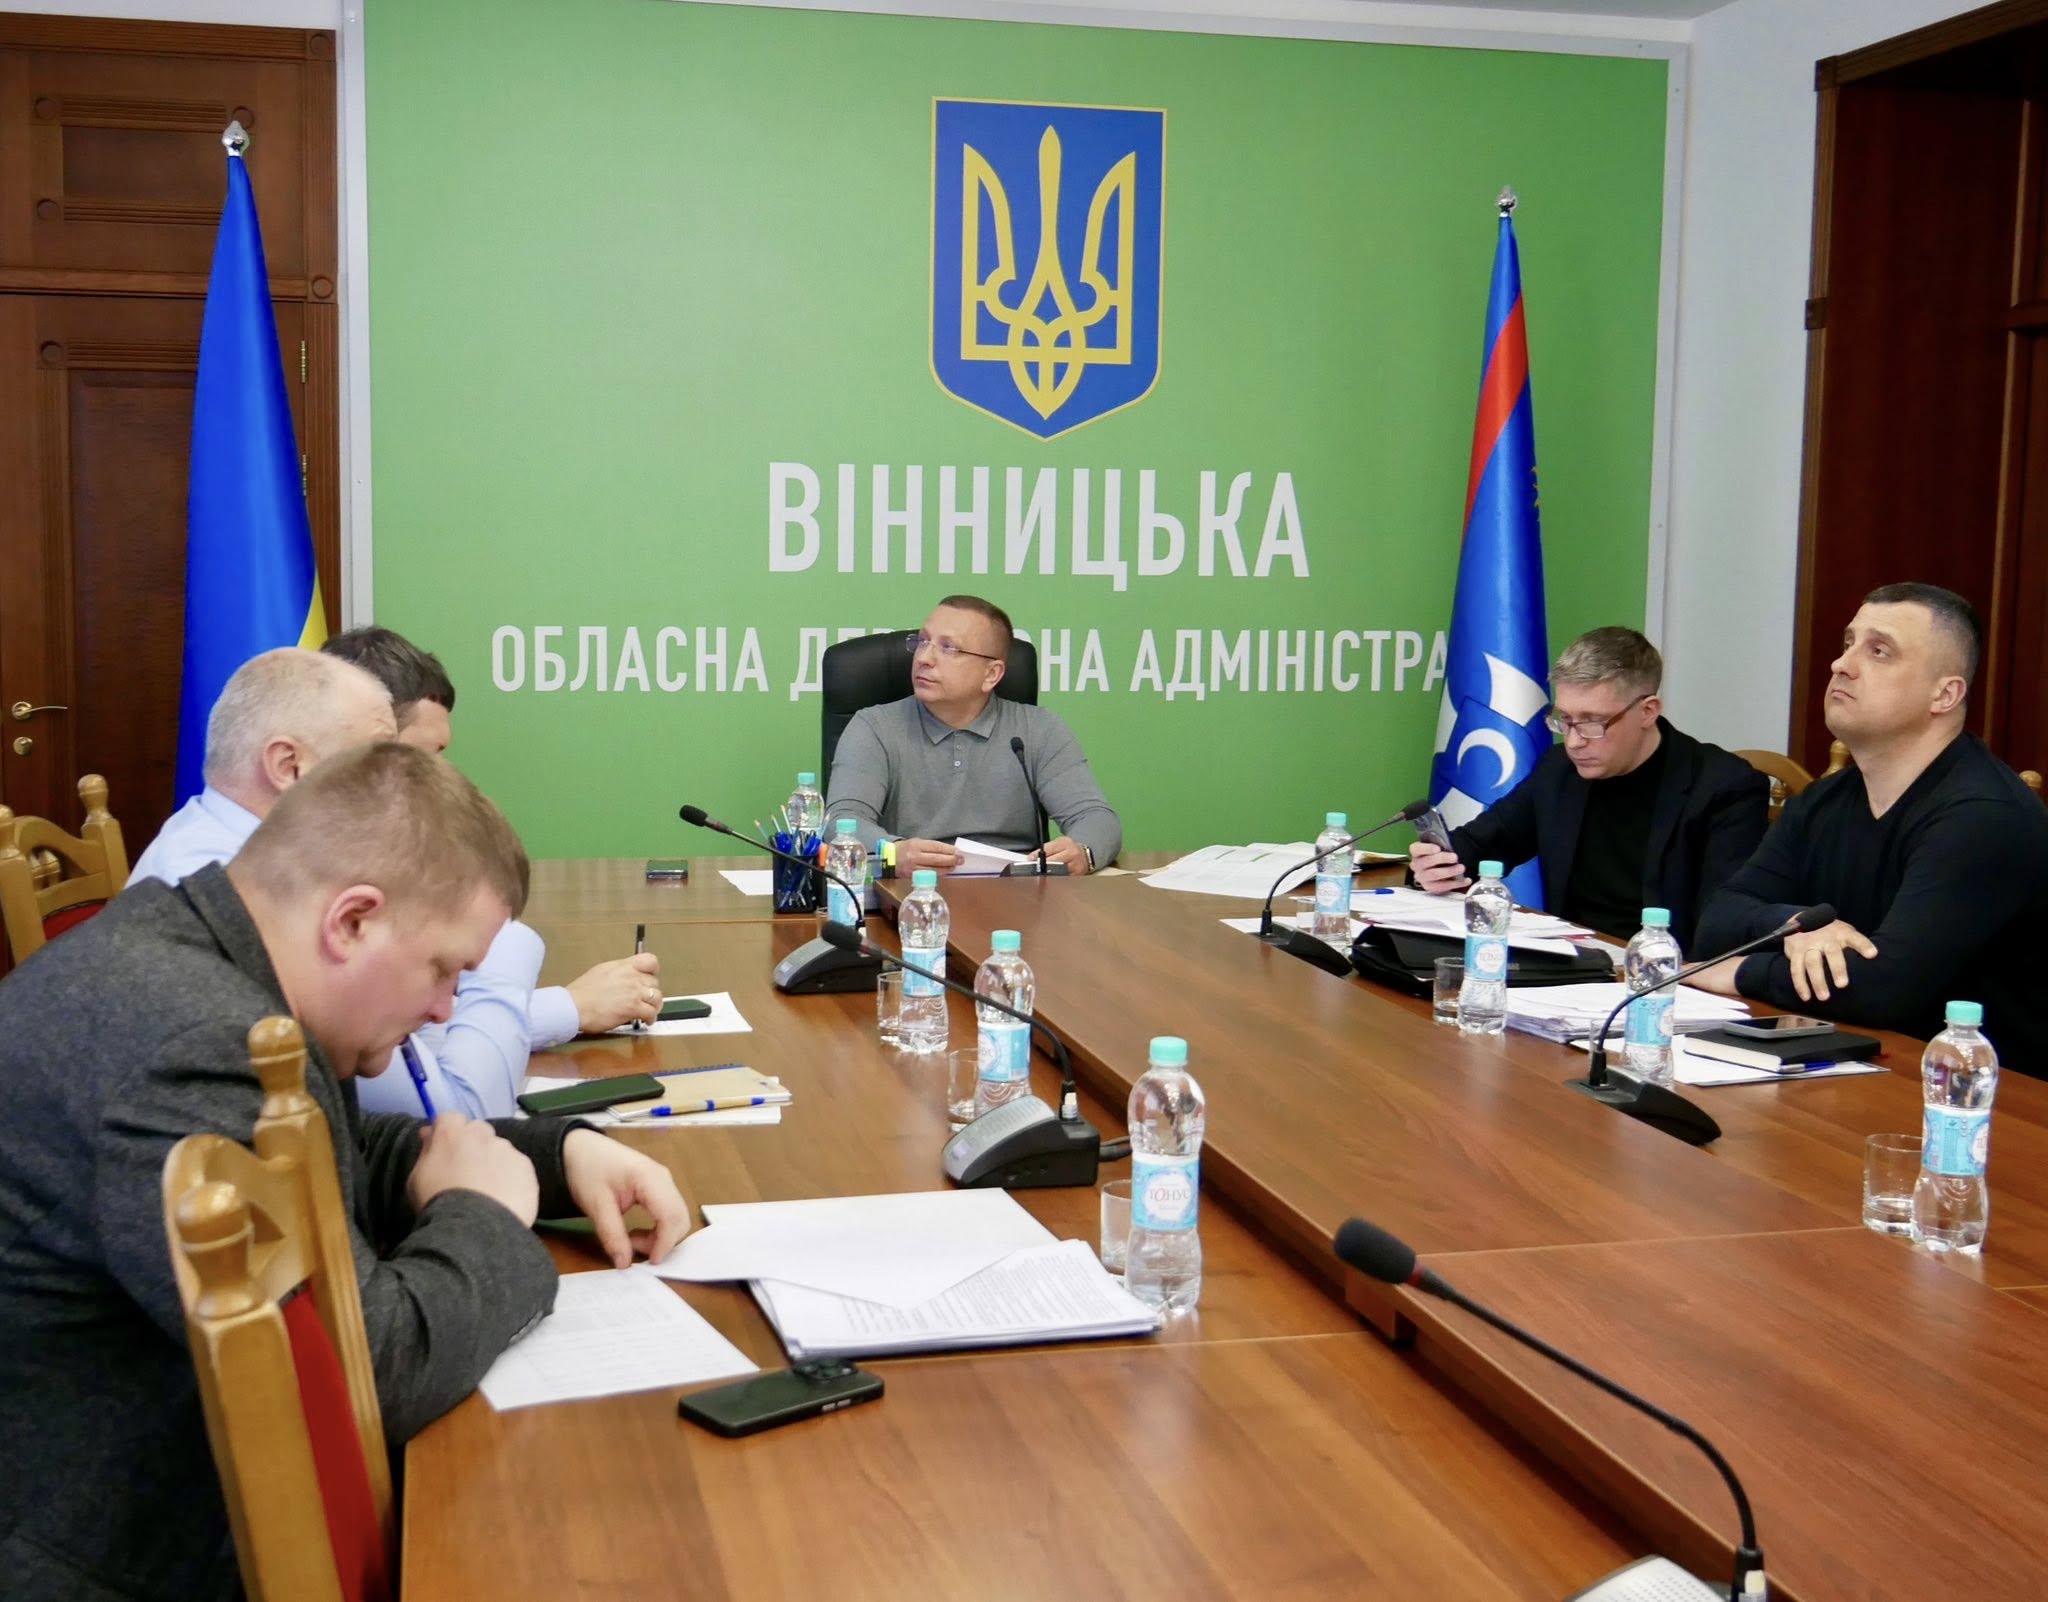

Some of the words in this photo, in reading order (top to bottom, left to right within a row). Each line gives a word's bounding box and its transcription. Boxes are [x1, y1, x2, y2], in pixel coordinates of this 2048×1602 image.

[767, 457, 1310, 592] ВІННИЦЬКА
[491, 625, 770, 693] ОБЛАСНА
[1129, 629, 1448, 701] АДМІНІСТРА
